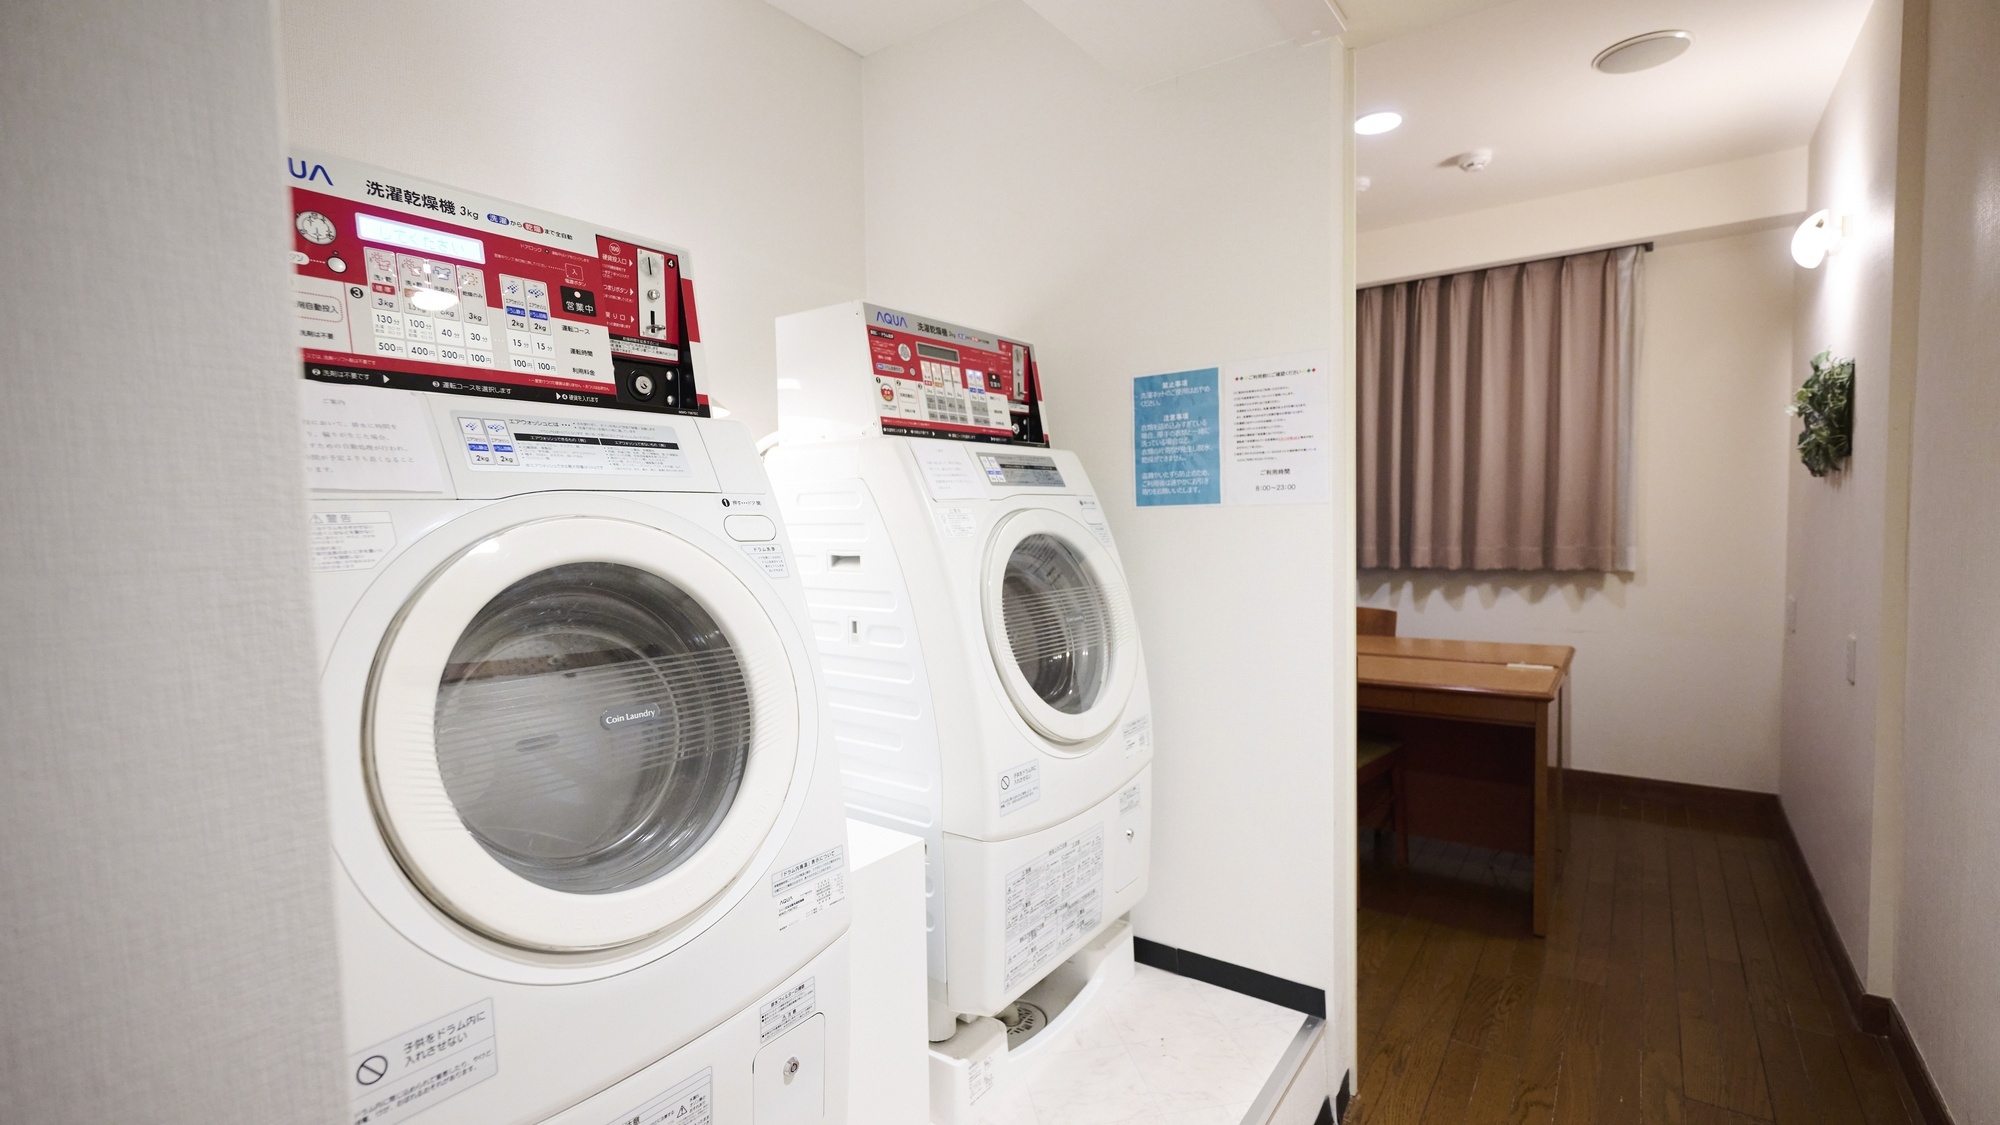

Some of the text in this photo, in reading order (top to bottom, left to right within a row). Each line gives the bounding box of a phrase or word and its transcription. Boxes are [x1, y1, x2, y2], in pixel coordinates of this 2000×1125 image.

[366, 180, 479, 220] 洗濯乾燥機 3kg
[379, 226, 465, 254] してください
[668, 259, 673, 268] 4
[378, 298, 394, 308] 3kg
[566, 300, 593, 313] 営業中
[468, 312, 482, 322] 3kg
[876, 311, 908, 328] AQUA
[511, 319, 524, 328] 2kg
[534, 323, 547, 332] 2kg
[562, 325, 590, 335] 運転コース
[378, 341, 404, 353] 500円
[411, 346, 435, 357] 400円
[441, 350, 465, 361] 300円
[471, 353, 492, 364] 100円
[513, 359, 533, 369] 100円
[537, 362, 556, 372] 100円
[476, 454, 490, 463] 2kg
[500, 455, 513, 463] 2kg
[1260, 468, 1291, 476] ご利用時間
[606, 709, 656, 725] Coin Laundry
[403, 1011, 486, 1054] 子供をドラム内に
[404, 1032, 468, 1067] 入れさせない
